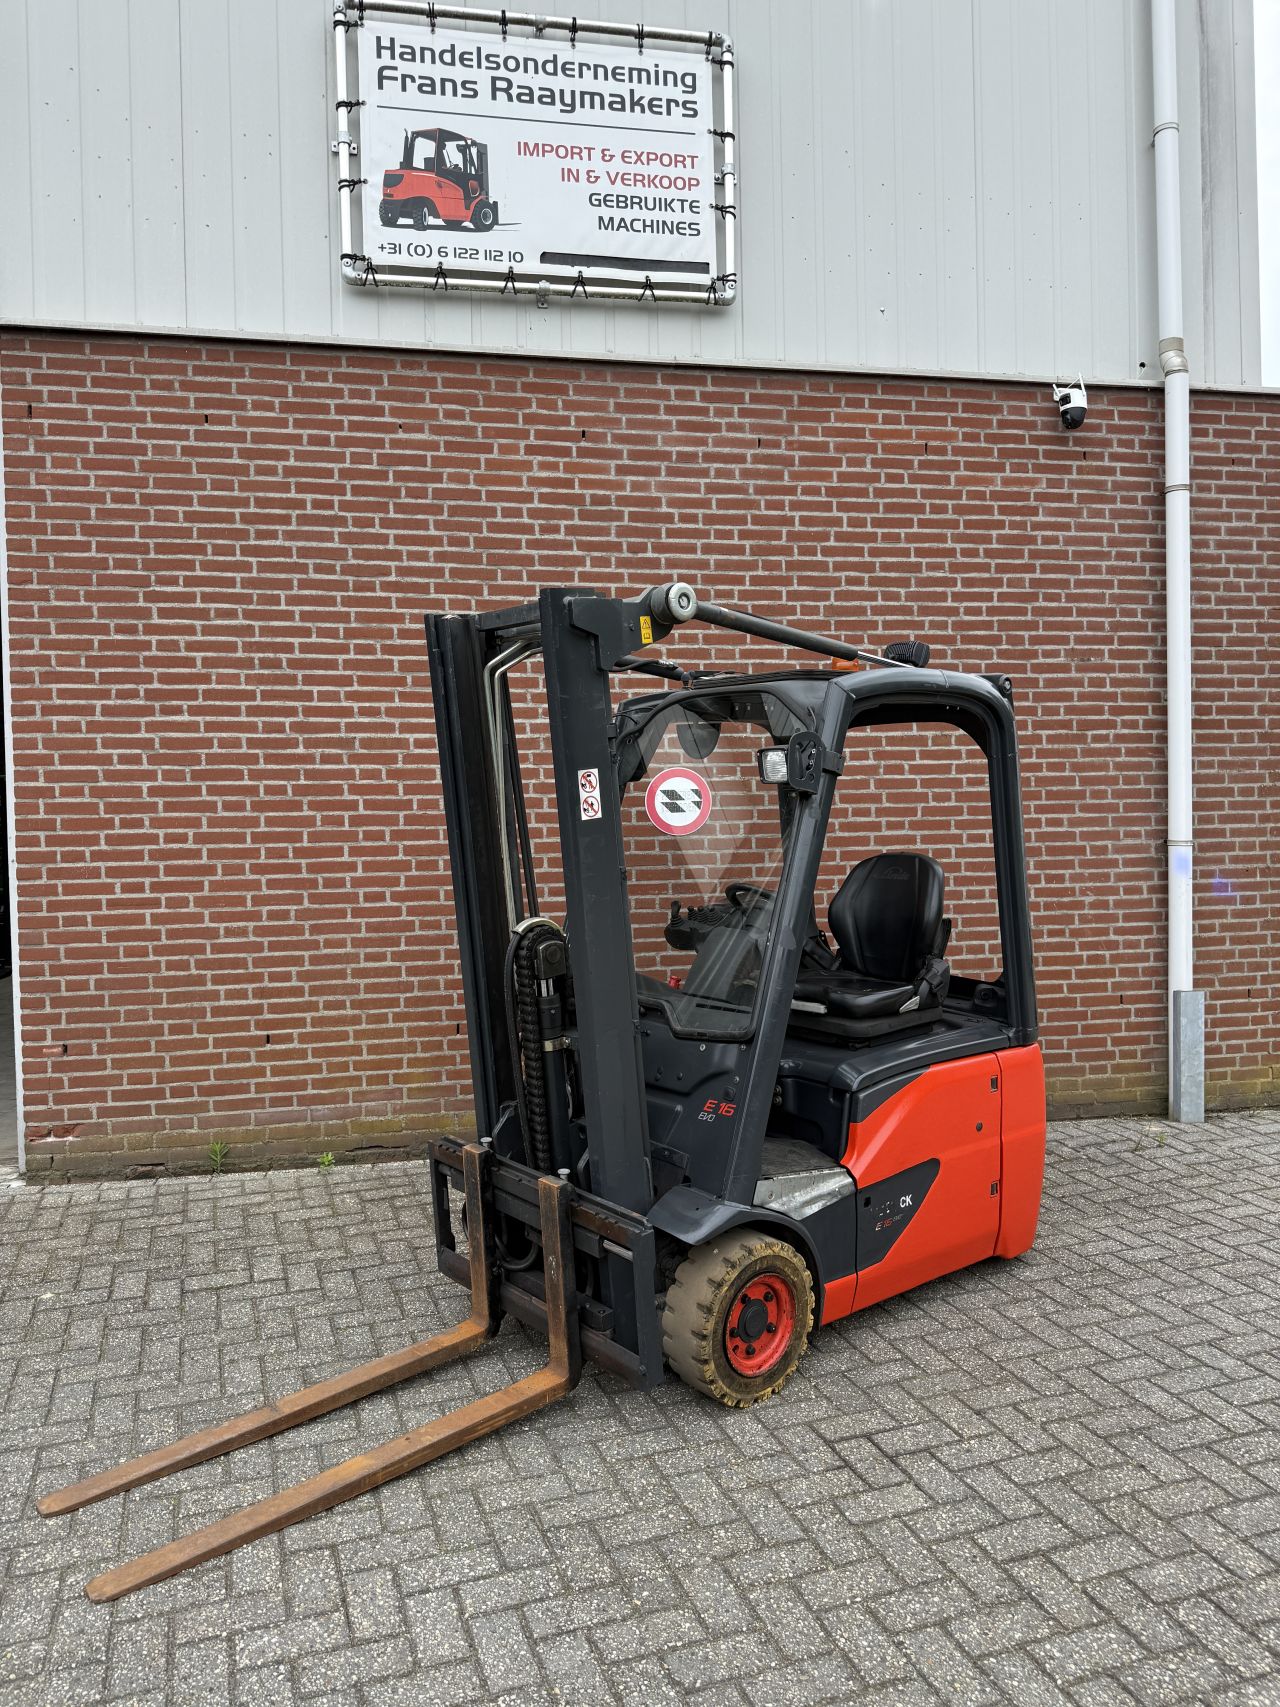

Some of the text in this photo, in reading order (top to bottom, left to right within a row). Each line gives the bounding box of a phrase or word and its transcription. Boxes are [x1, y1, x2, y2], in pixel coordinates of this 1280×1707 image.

[375, 36, 697, 95] Handelsonderneming
[377, 66, 699, 118] Frans Raaymakers
[517, 141, 699, 170] IMPORT & EXPORT
[561, 167, 701, 192] IN & VERKOOP
[588, 193, 701, 215] GEBRUIKTE
[598, 216, 701, 237] MACHINES
[377, 243, 402, 255] +31
[406, 243, 433, 258] (0)
[437, 246, 449, 258] 6
[453, 246, 480, 260] 122
[508, 250, 524, 263] 10
